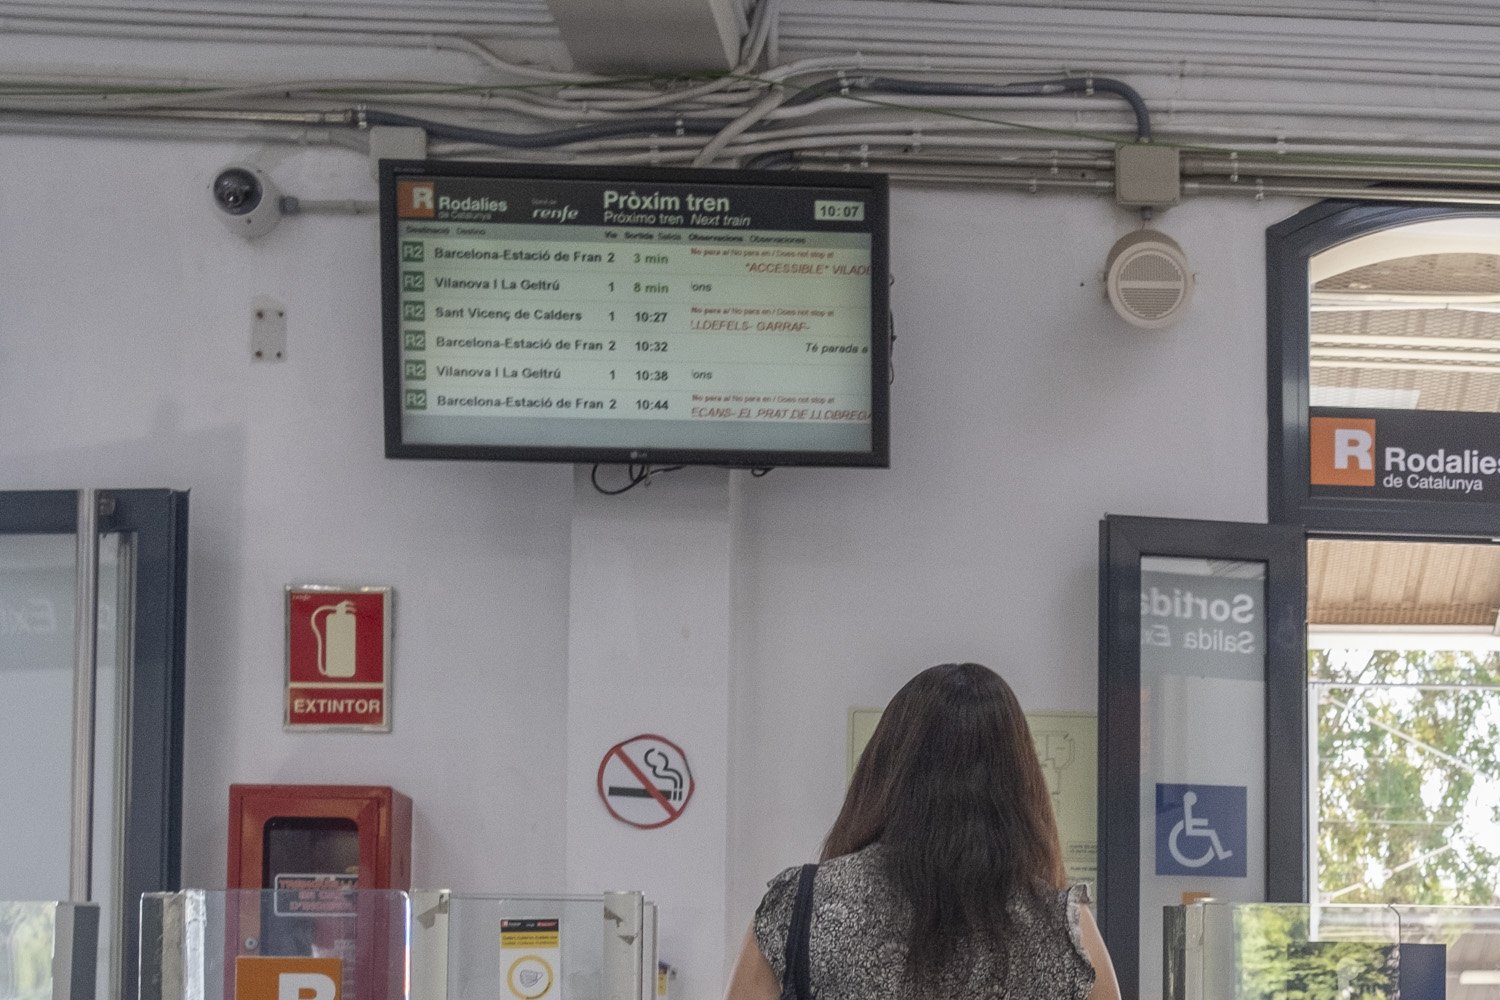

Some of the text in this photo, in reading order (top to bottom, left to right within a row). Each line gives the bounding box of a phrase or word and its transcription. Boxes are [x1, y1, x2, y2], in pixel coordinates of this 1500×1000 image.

[412, 186, 434, 209] R
[439, 196, 508, 212] Rodalies
[604, 190, 730, 212] Pròxim tren
[533, 204, 579, 223] renfe
[604, 211, 751, 227] Próximo tren Next train
[820, 205, 859, 218] 10:07
[403, 243, 668, 264] R2 Barcelona-Estació de Fran 2 3 min
[404, 273, 424, 291] R2
[435, 277, 490, 289] Vilanova
[501, 279, 516, 290] La
[520, 278, 560, 291] Geltrú
[608, 281, 616, 292] 1
[633, 282, 643, 293] 8
[645, 282, 669, 293] min
[404, 303, 668, 323] R2 Sant Vicenç de Calders 1 10:27
[405, 332, 425, 350] R2
[436, 336, 552, 350] Barcelona-Estació
[555, 339, 571, 350] de
[574, 340, 603, 351] Fran
[608, 340, 616, 351] 2
[635, 340, 668, 352] 10:32
[805, 342, 818, 352] Té
[821, 343, 859, 354] parada
[405, 362, 426, 380] R2
[436, 366, 491, 378] Vilanova
[503, 367, 518, 379] La
[522, 367, 561, 380] Geltrú
[610, 370, 617, 381] 1
[635, 369, 668, 381] 10:38
[406, 391, 669, 411] R2 Barcelona-Estació de Fran 2 10:44
[1334, 428, 1373, 471] R
[1383, 475, 1483, 494] de Catalunya
[294, 699, 381, 714] EXTINTOR
